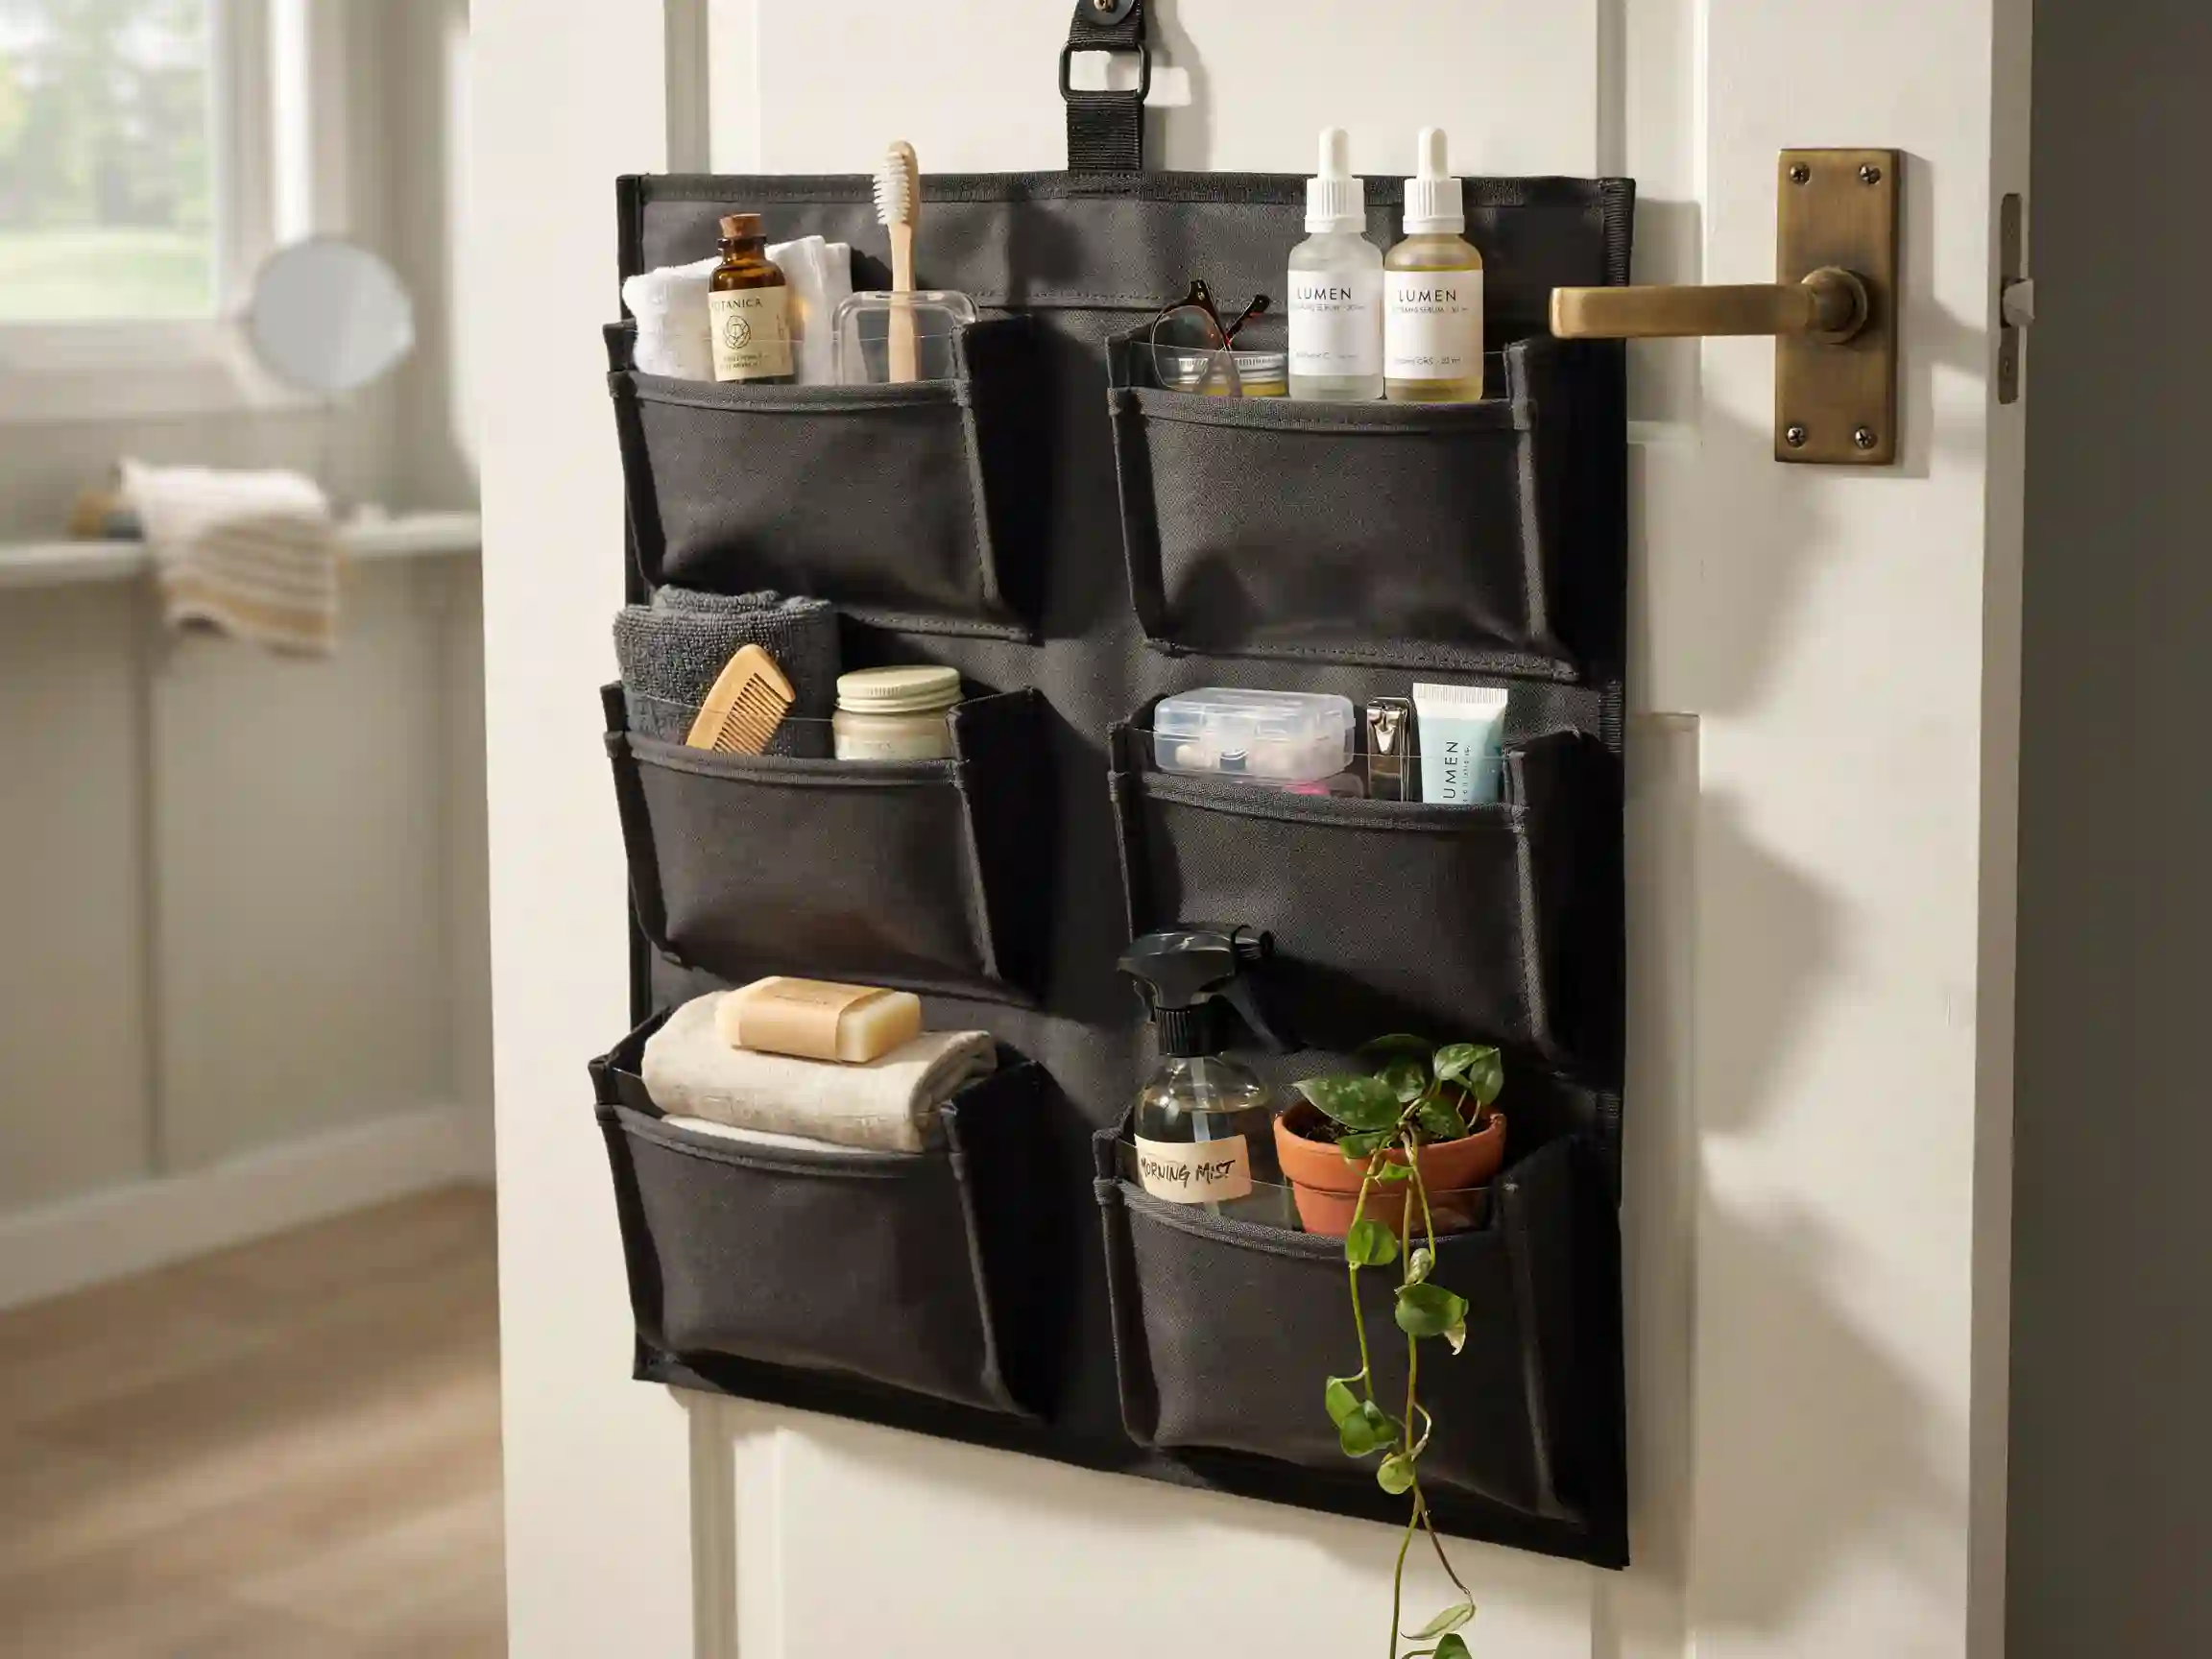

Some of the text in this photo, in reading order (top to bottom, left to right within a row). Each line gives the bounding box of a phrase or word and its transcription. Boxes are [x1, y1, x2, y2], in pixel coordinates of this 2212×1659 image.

[1297, 287, 1352, 301] LUMEN
[1399, 289, 1456, 302] LUMEN
[1442, 741, 1459, 799] UMEN
